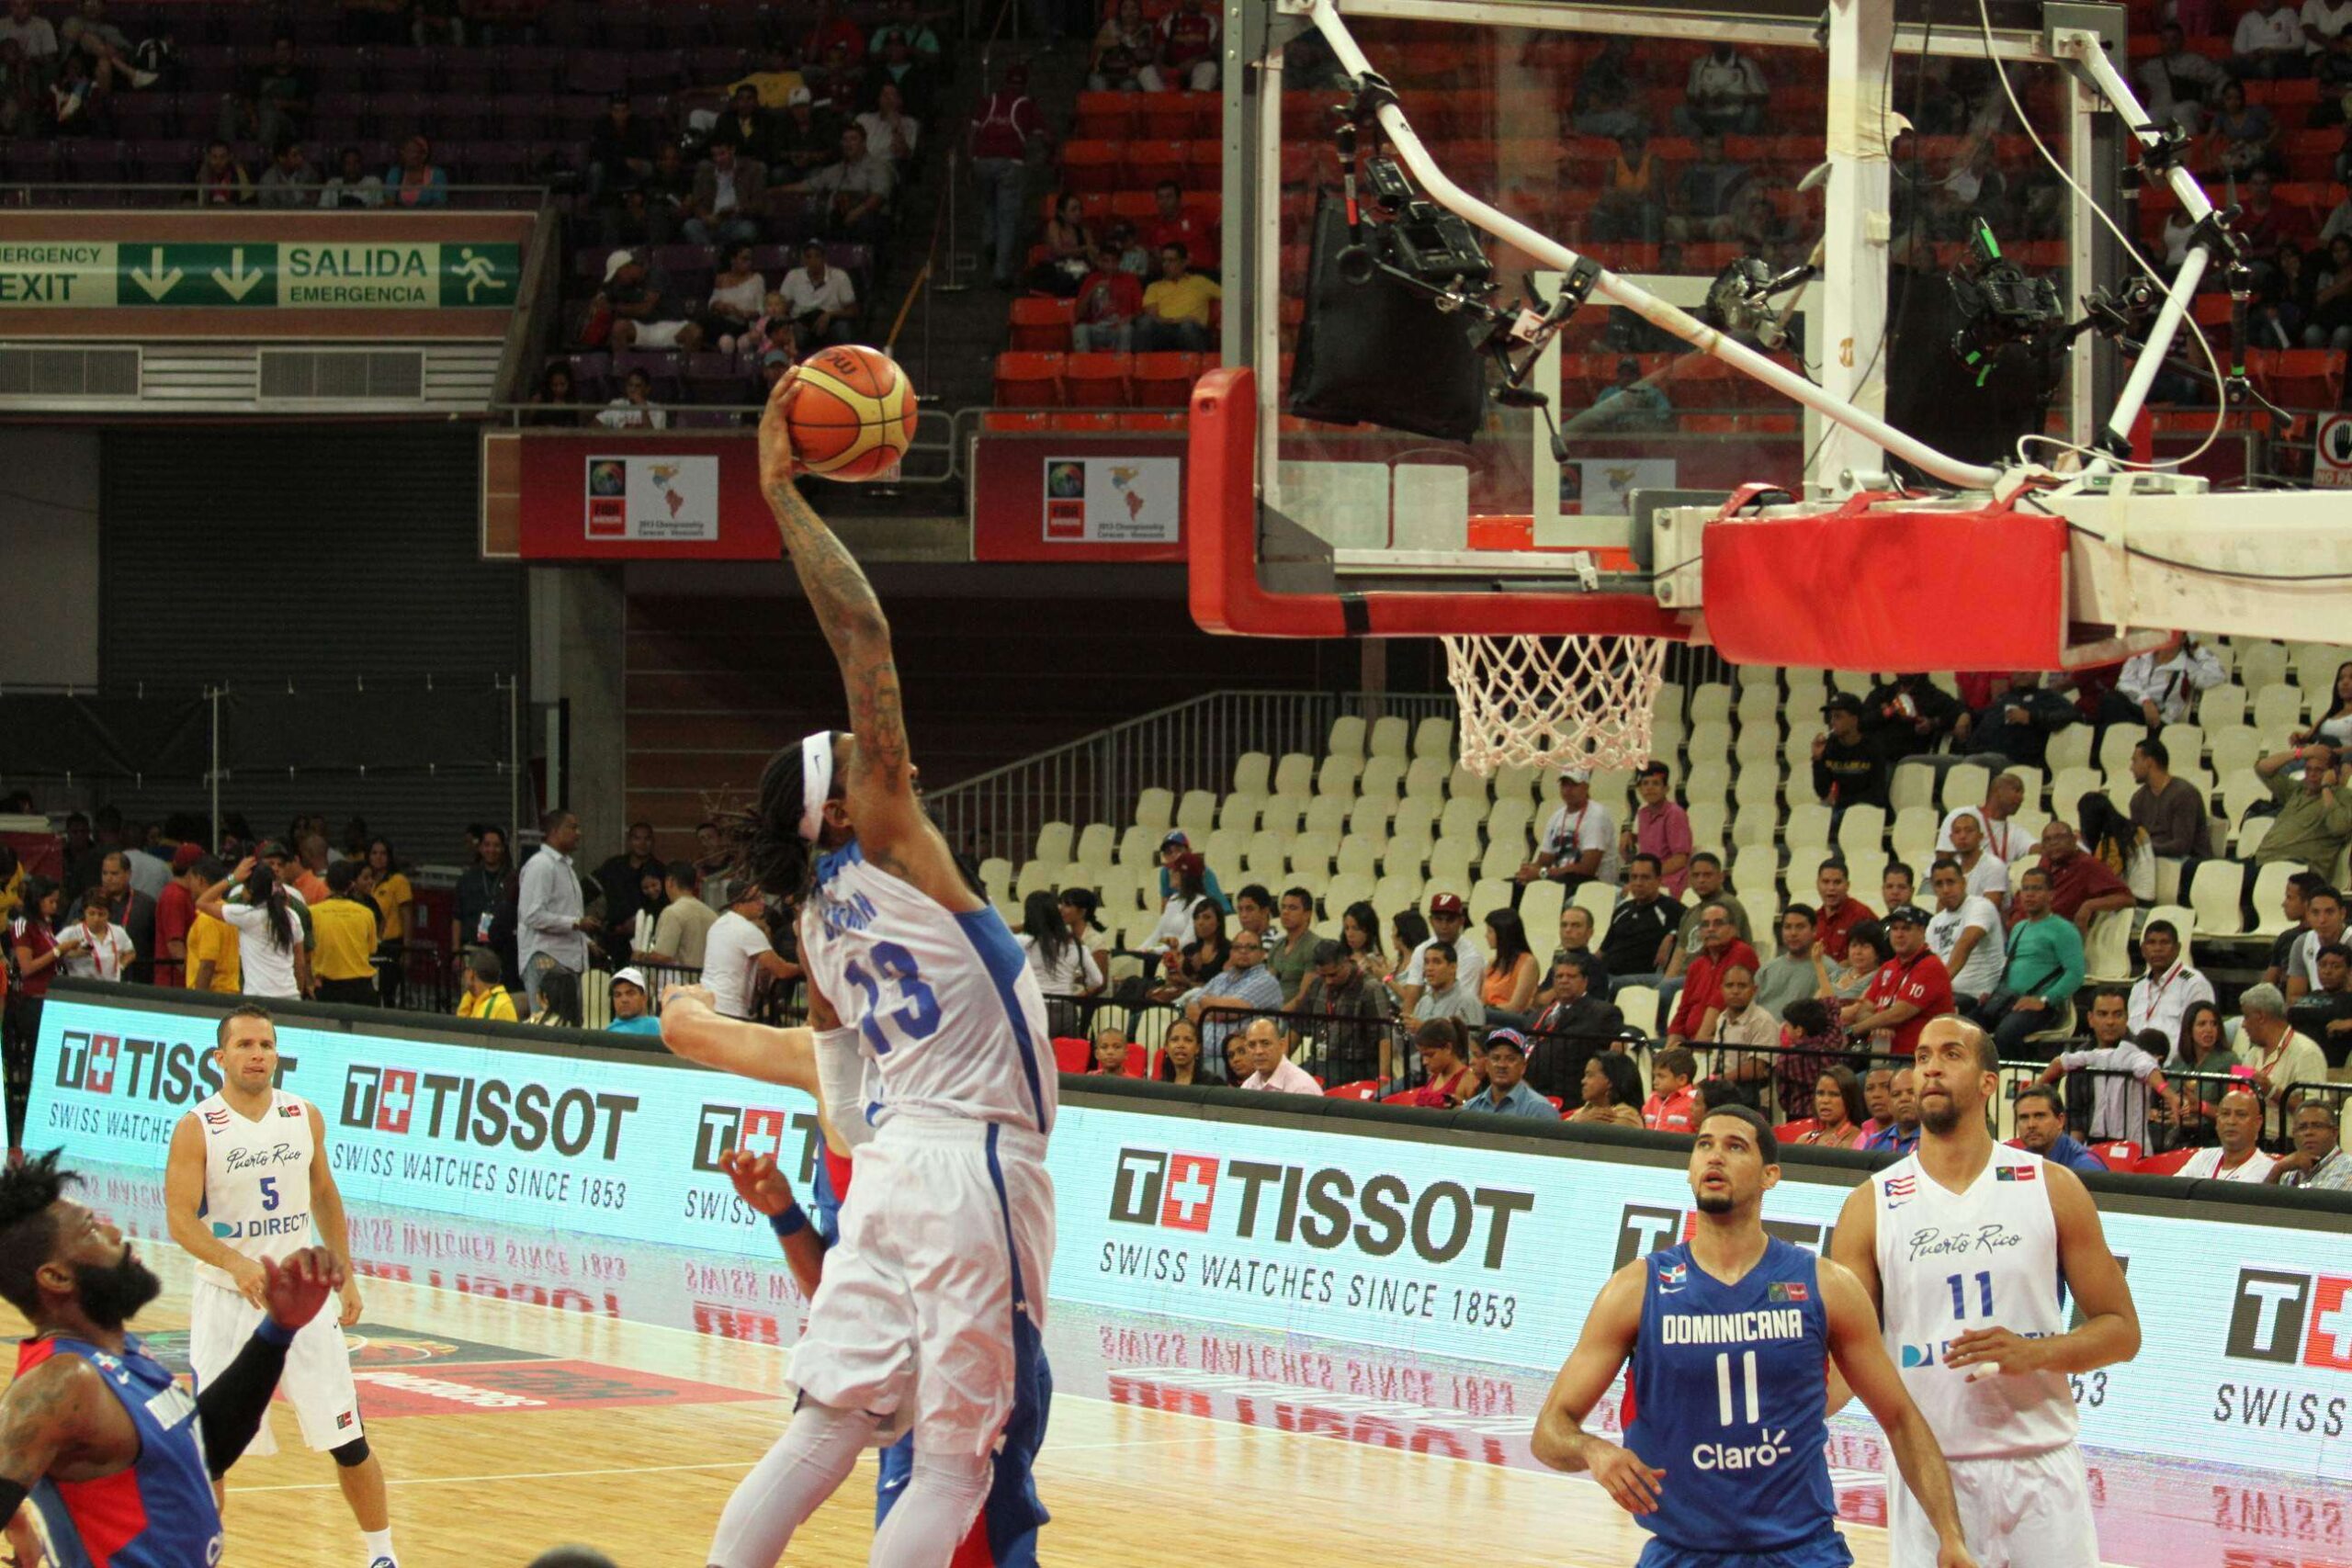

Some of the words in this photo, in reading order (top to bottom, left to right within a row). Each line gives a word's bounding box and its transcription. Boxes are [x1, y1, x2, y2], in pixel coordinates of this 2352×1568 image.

[0, 246, 101, 264] ERGENCY
[288, 248, 427, 277] SALIDA
[0, 273, 77, 301] EXIT
[290, 286, 425, 302] EMERGENCIA
[843, 940, 943, 1055] 13
[1908, 983, 1925, 998] 10
[125, 1037, 298, 1105] TISST
[49, 1101, 99, 1134] SWISS
[107, 1114, 171, 1145] WATCHE
[423, 1072, 639, 1161] TISSOT
[226, 1146, 269, 1174] Puerto
[272, 1143, 301, 1167] Rico
[333, 1143, 395, 1178] SWISS
[403, 1153, 497, 1191] WATCHES
[506, 1167, 571, 1201] SINCE
[581, 1177, 627, 1211] 1853
[259, 1176, 279, 1212] 5
[1227, 1159, 1534, 1270] TISSOT
[1908, 1226, 1971, 1262] Puerto
[1974, 1224, 2022, 1255] Rico
[1100, 1241, 1188, 1283] SWISS
[1201, 1253, 1334, 1303] WATCHES
[1347, 1273, 1438, 1318] SINCE
[1453, 1289, 1516, 1330] 1853
[1946, 1269, 1994, 1321] 11
[1661, 1308, 1804, 1346] DOMINICANA
[1715, 1350, 1760, 1427] 11
[2213, 1382, 2346, 1437] SWISS
[1692, 1438, 1781, 1471] Claro
